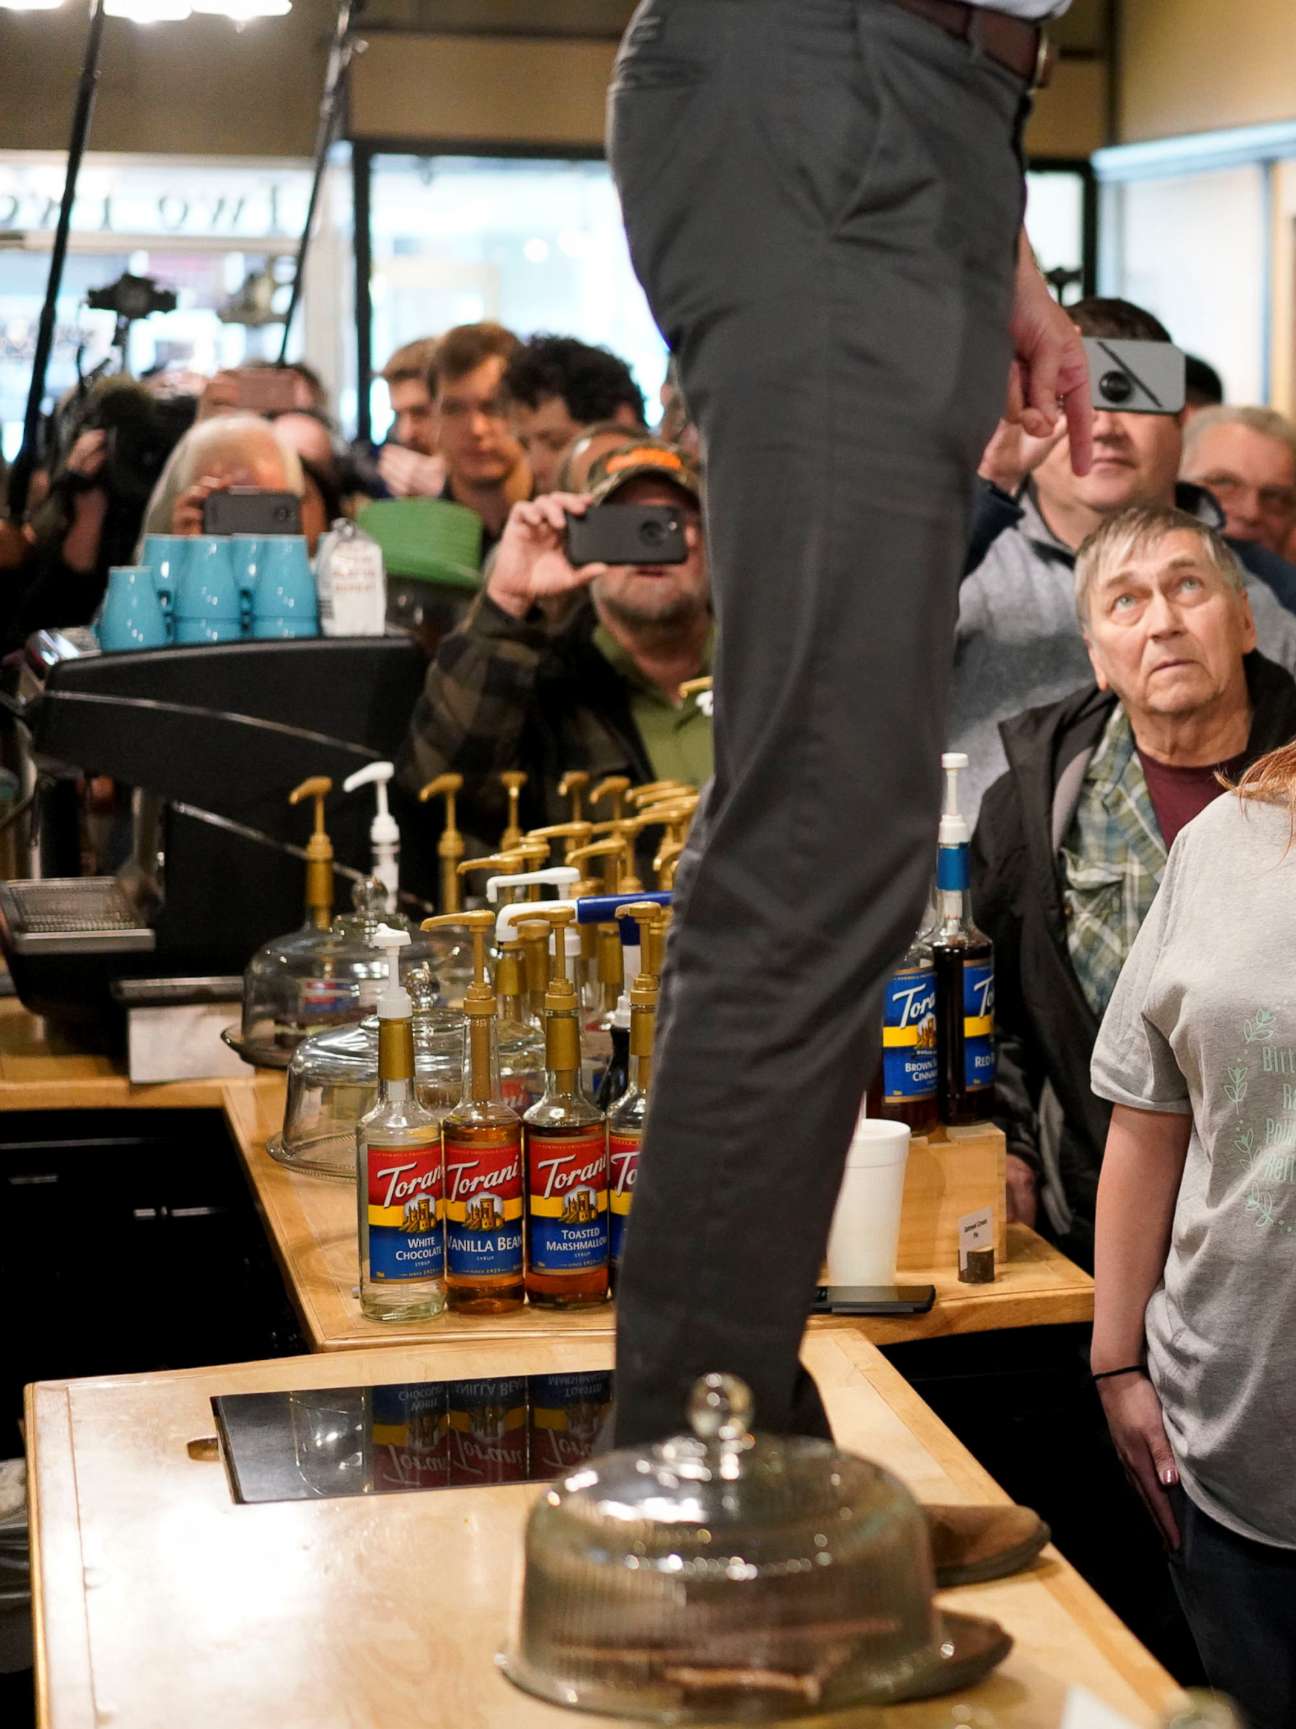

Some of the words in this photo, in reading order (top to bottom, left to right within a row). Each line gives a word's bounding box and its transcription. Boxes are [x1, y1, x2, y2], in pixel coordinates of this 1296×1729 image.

[447, 1154, 519, 1204] Torani
[561, 1227, 600, 1240] TOASTED
[407, 1236, 436, 1249] WHITE
